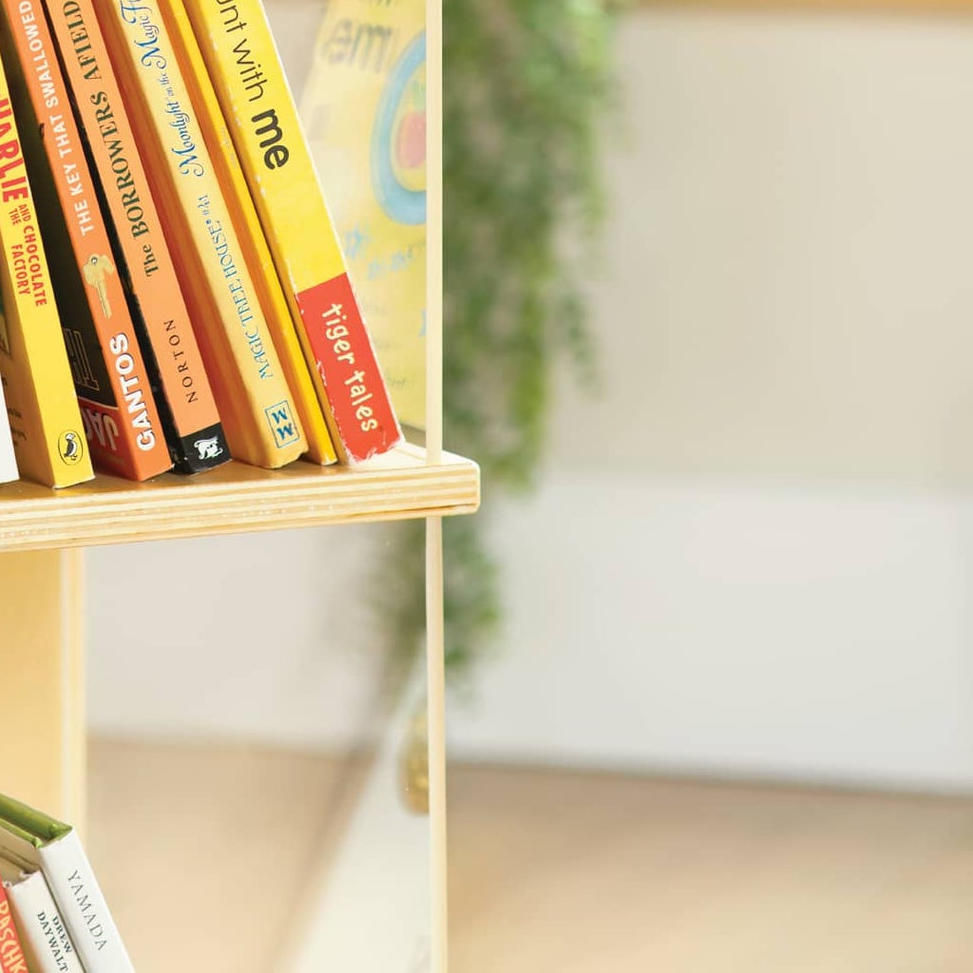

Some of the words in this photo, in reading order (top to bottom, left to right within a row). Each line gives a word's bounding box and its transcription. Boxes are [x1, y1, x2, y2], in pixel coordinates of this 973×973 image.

[18, 0, 59, 109] SWALLOWED
[63, 0, 102, 80] AFIELD
[134, 15, 167, 69] Magic
[232, 38, 268, 102] with
[251, 108, 290, 170] me
[49, 114, 73, 159] THAT
[90, 90, 150, 240] BORROWERS
[166, 101, 205, 177] Moonlight
[63, 163, 83, 196] KEY
[8, 208, 22, 226] THE
[18, 203, 32, 222] AND
[75, 199, 94, 237] THE
[11, 244, 31, 296] FACTORY
[23, 225, 48, 307] CHOCOLATE
[143, 244, 159, 277] The
[227, 278, 254, 329] TREE
[163, 319, 198, 404] NORTON
[245, 326, 274, 380] MAGIC
[321, 303, 355, 365] tiger
[344, 370, 378, 433] tales
[109, 332, 157, 452] GANTOS
[52, 915, 74, 954] DREW
[67, 869, 109, 952] YAMADA
[37, 911, 70, 972] DAYWALT
